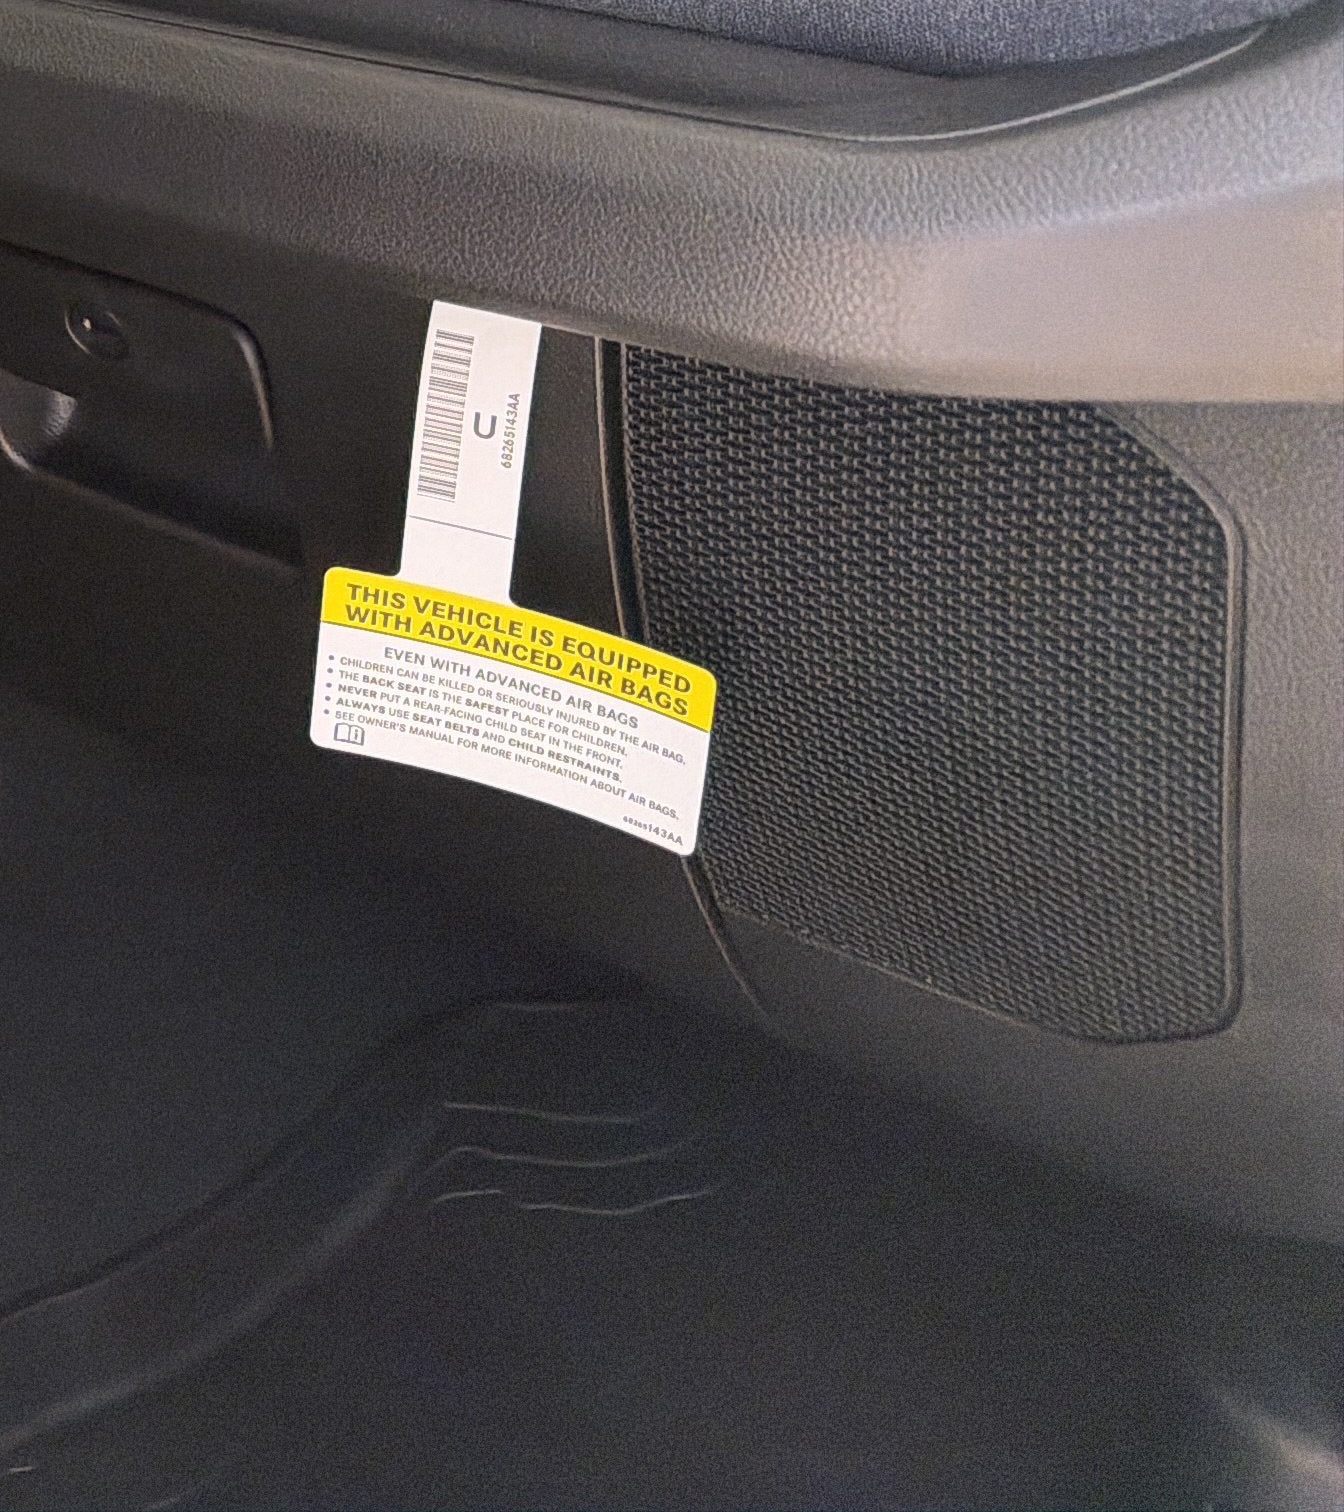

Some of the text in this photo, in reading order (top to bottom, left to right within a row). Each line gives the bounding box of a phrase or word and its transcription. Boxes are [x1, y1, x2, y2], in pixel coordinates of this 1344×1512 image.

[473, 411, 497, 440] U
[500, 393, 521, 469] 68265143AA
[346, 604, 688, 717] WITH ADVANCED AIR BAGS
[347, 583, 692, 694] THIS VEHICLE IS EQUIPPED
[338, 683, 623, 769] NEVER PUT A REAR-FACING CHILD SEAT IN THE FRONT.
[339, 670, 628, 757] THE BACK SEAT IS THE SAFEST PLACE FOR CHILDREN.
[340, 656, 686, 765] CHILDREN CAN BE KILLED OR SERIOUSLY INJURED BY THE AIR BAG.
[385, 646, 639, 729] EVEN WITH ADVANCED AIR BAGS
[335, 710, 680, 820] SEE OWNER'S MANUAL FOR MORE INFORMATION ABOUT AIR BAGS.
[336, 697, 623, 783] ALWAYS USE SEAT BELTS AND CHILD RESTRAINTS.
